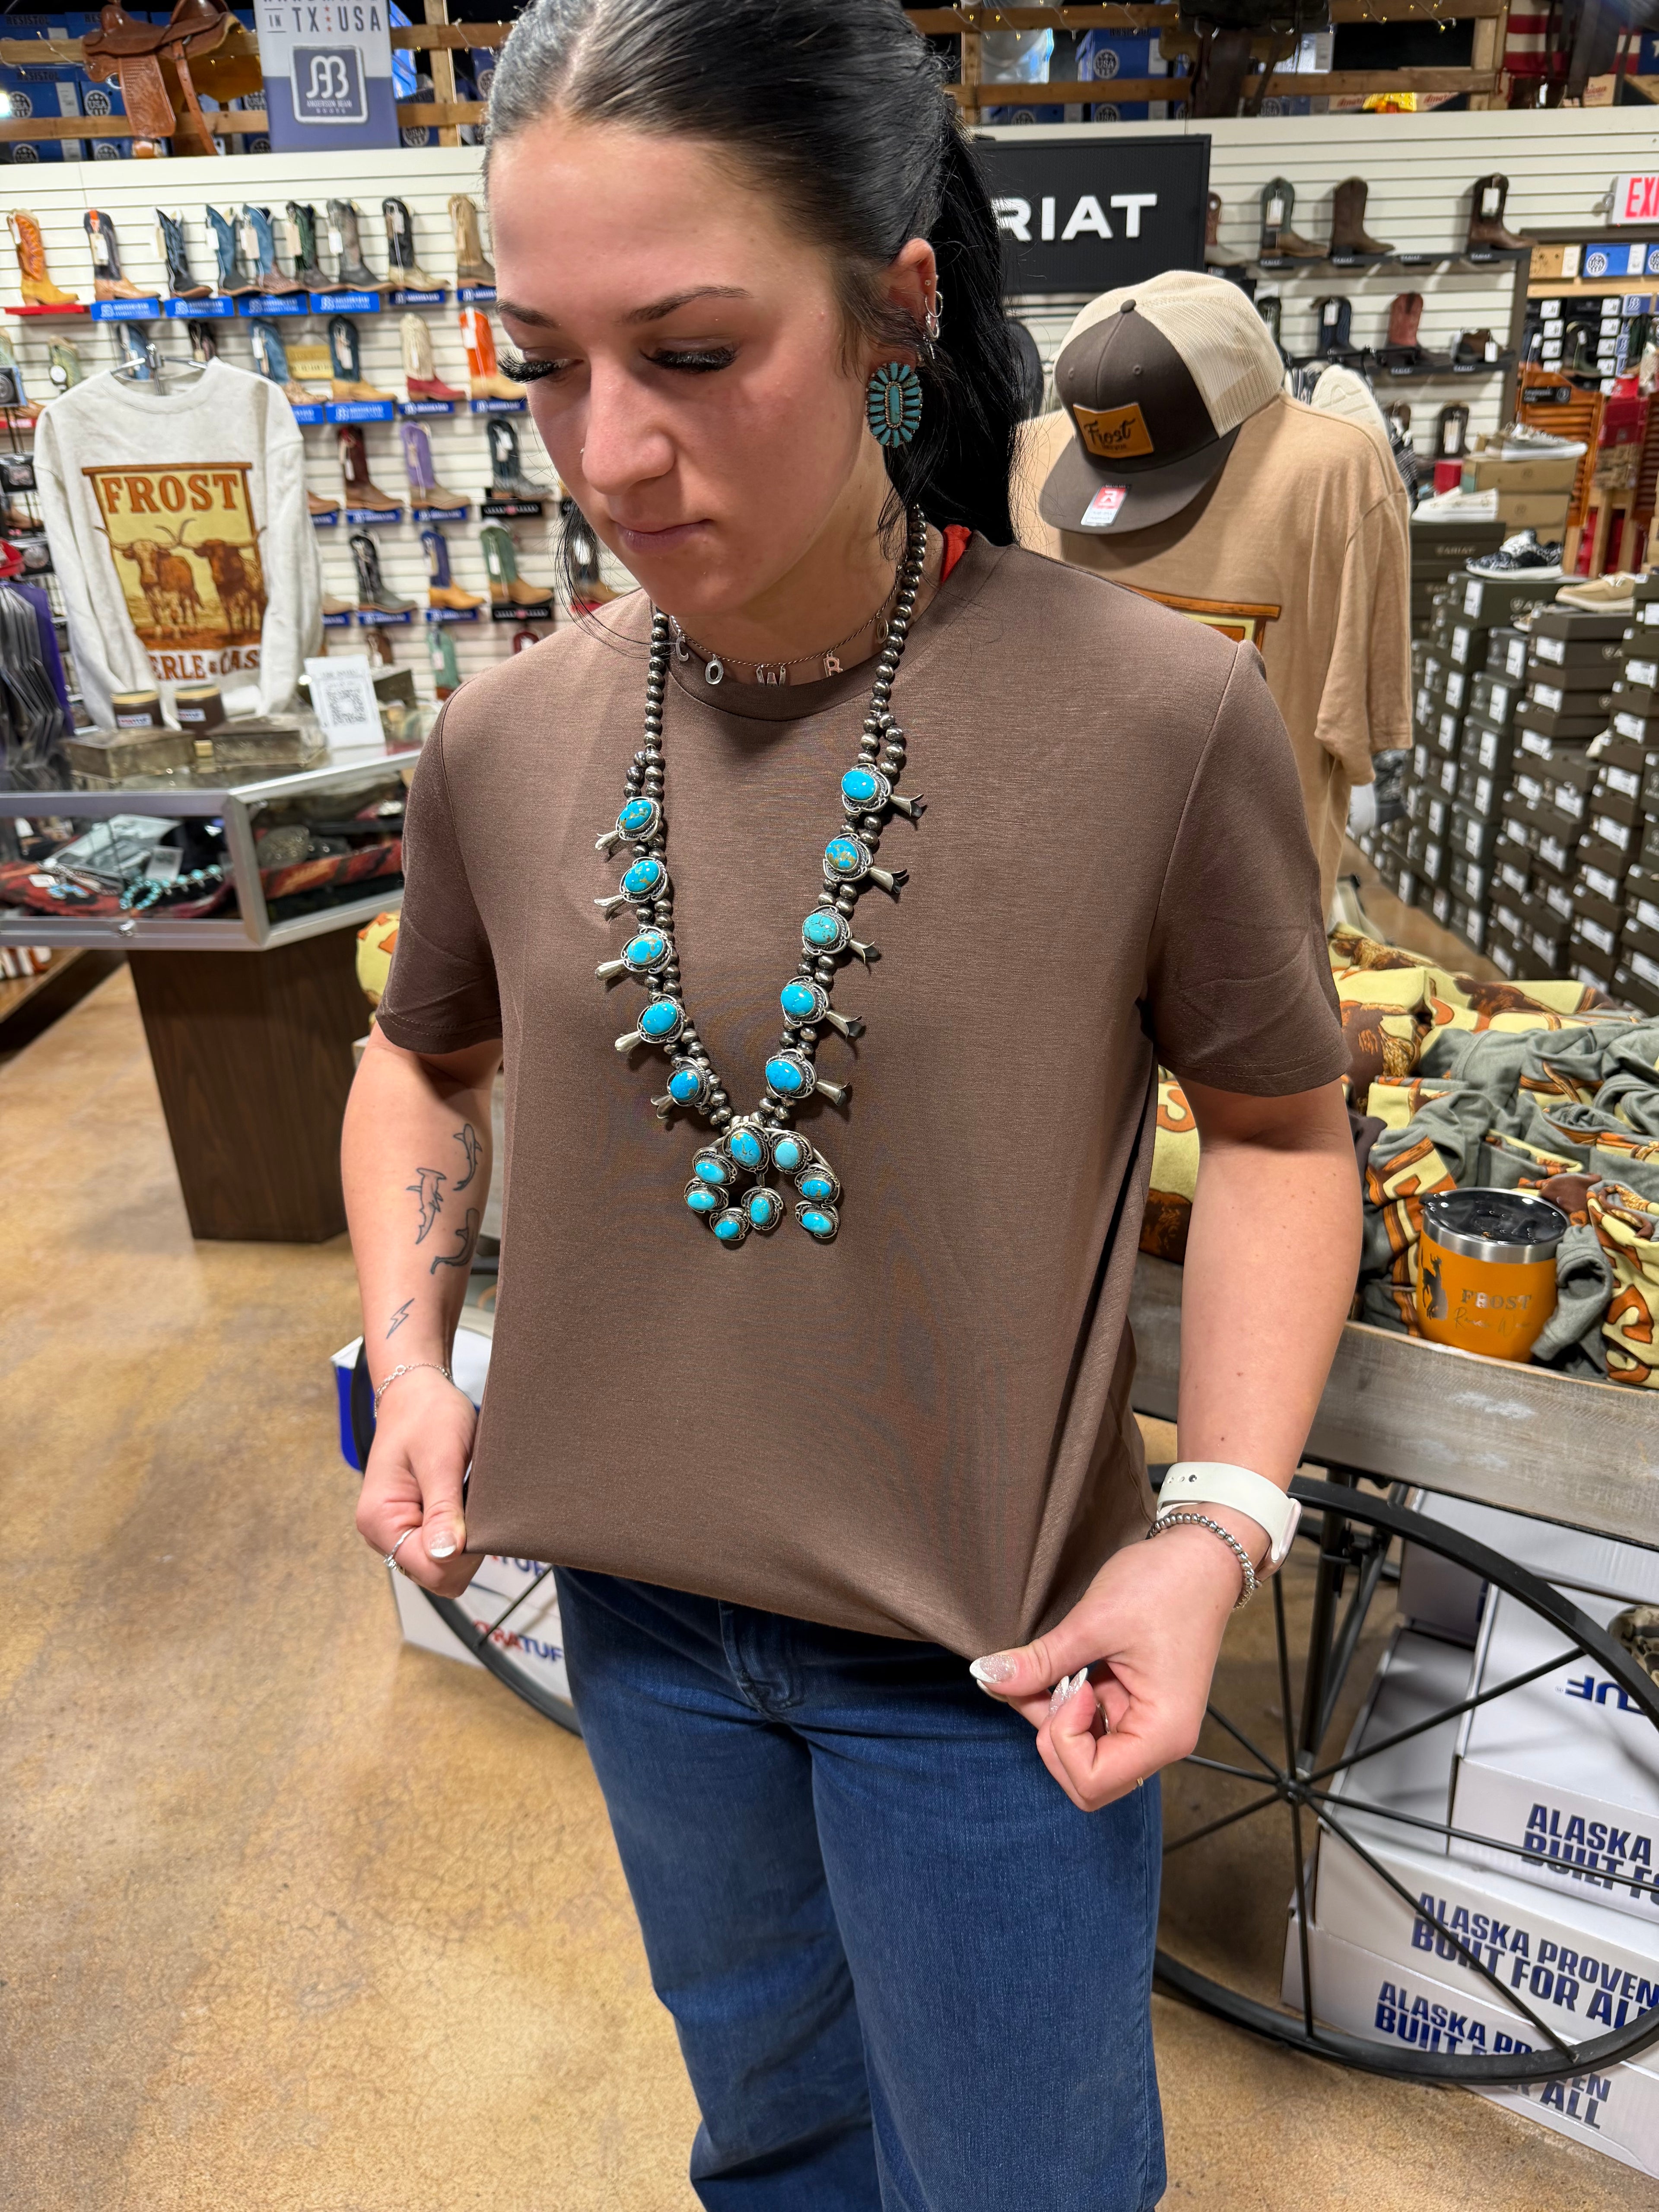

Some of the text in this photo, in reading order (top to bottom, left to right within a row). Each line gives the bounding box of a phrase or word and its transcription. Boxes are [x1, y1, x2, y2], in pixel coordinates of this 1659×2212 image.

[268, 6, 381, 32] IN TX USA
[1096, 60, 1114, 69] USA
[992, 194, 1157, 242] RIAT
[1625, 177, 1659, 217] EXI
[101, 474, 238, 513] FROST
[149, 655, 206, 680] ERLE
[220, 649, 259, 675] CAS
[1461, 1288, 1532, 1310] FROST
[1526, 1802, 1652, 1866] ALASKA
[1415, 1892, 1659, 2008] ALASKA PROVEN
[1379, 1981, 1486, 2047] ALASKA
[1511, 1955, 1580, 2012] FOR
[1585, 1988, 1651, 2029] AL
[1539, 2080, 1601, 2129] ALL
